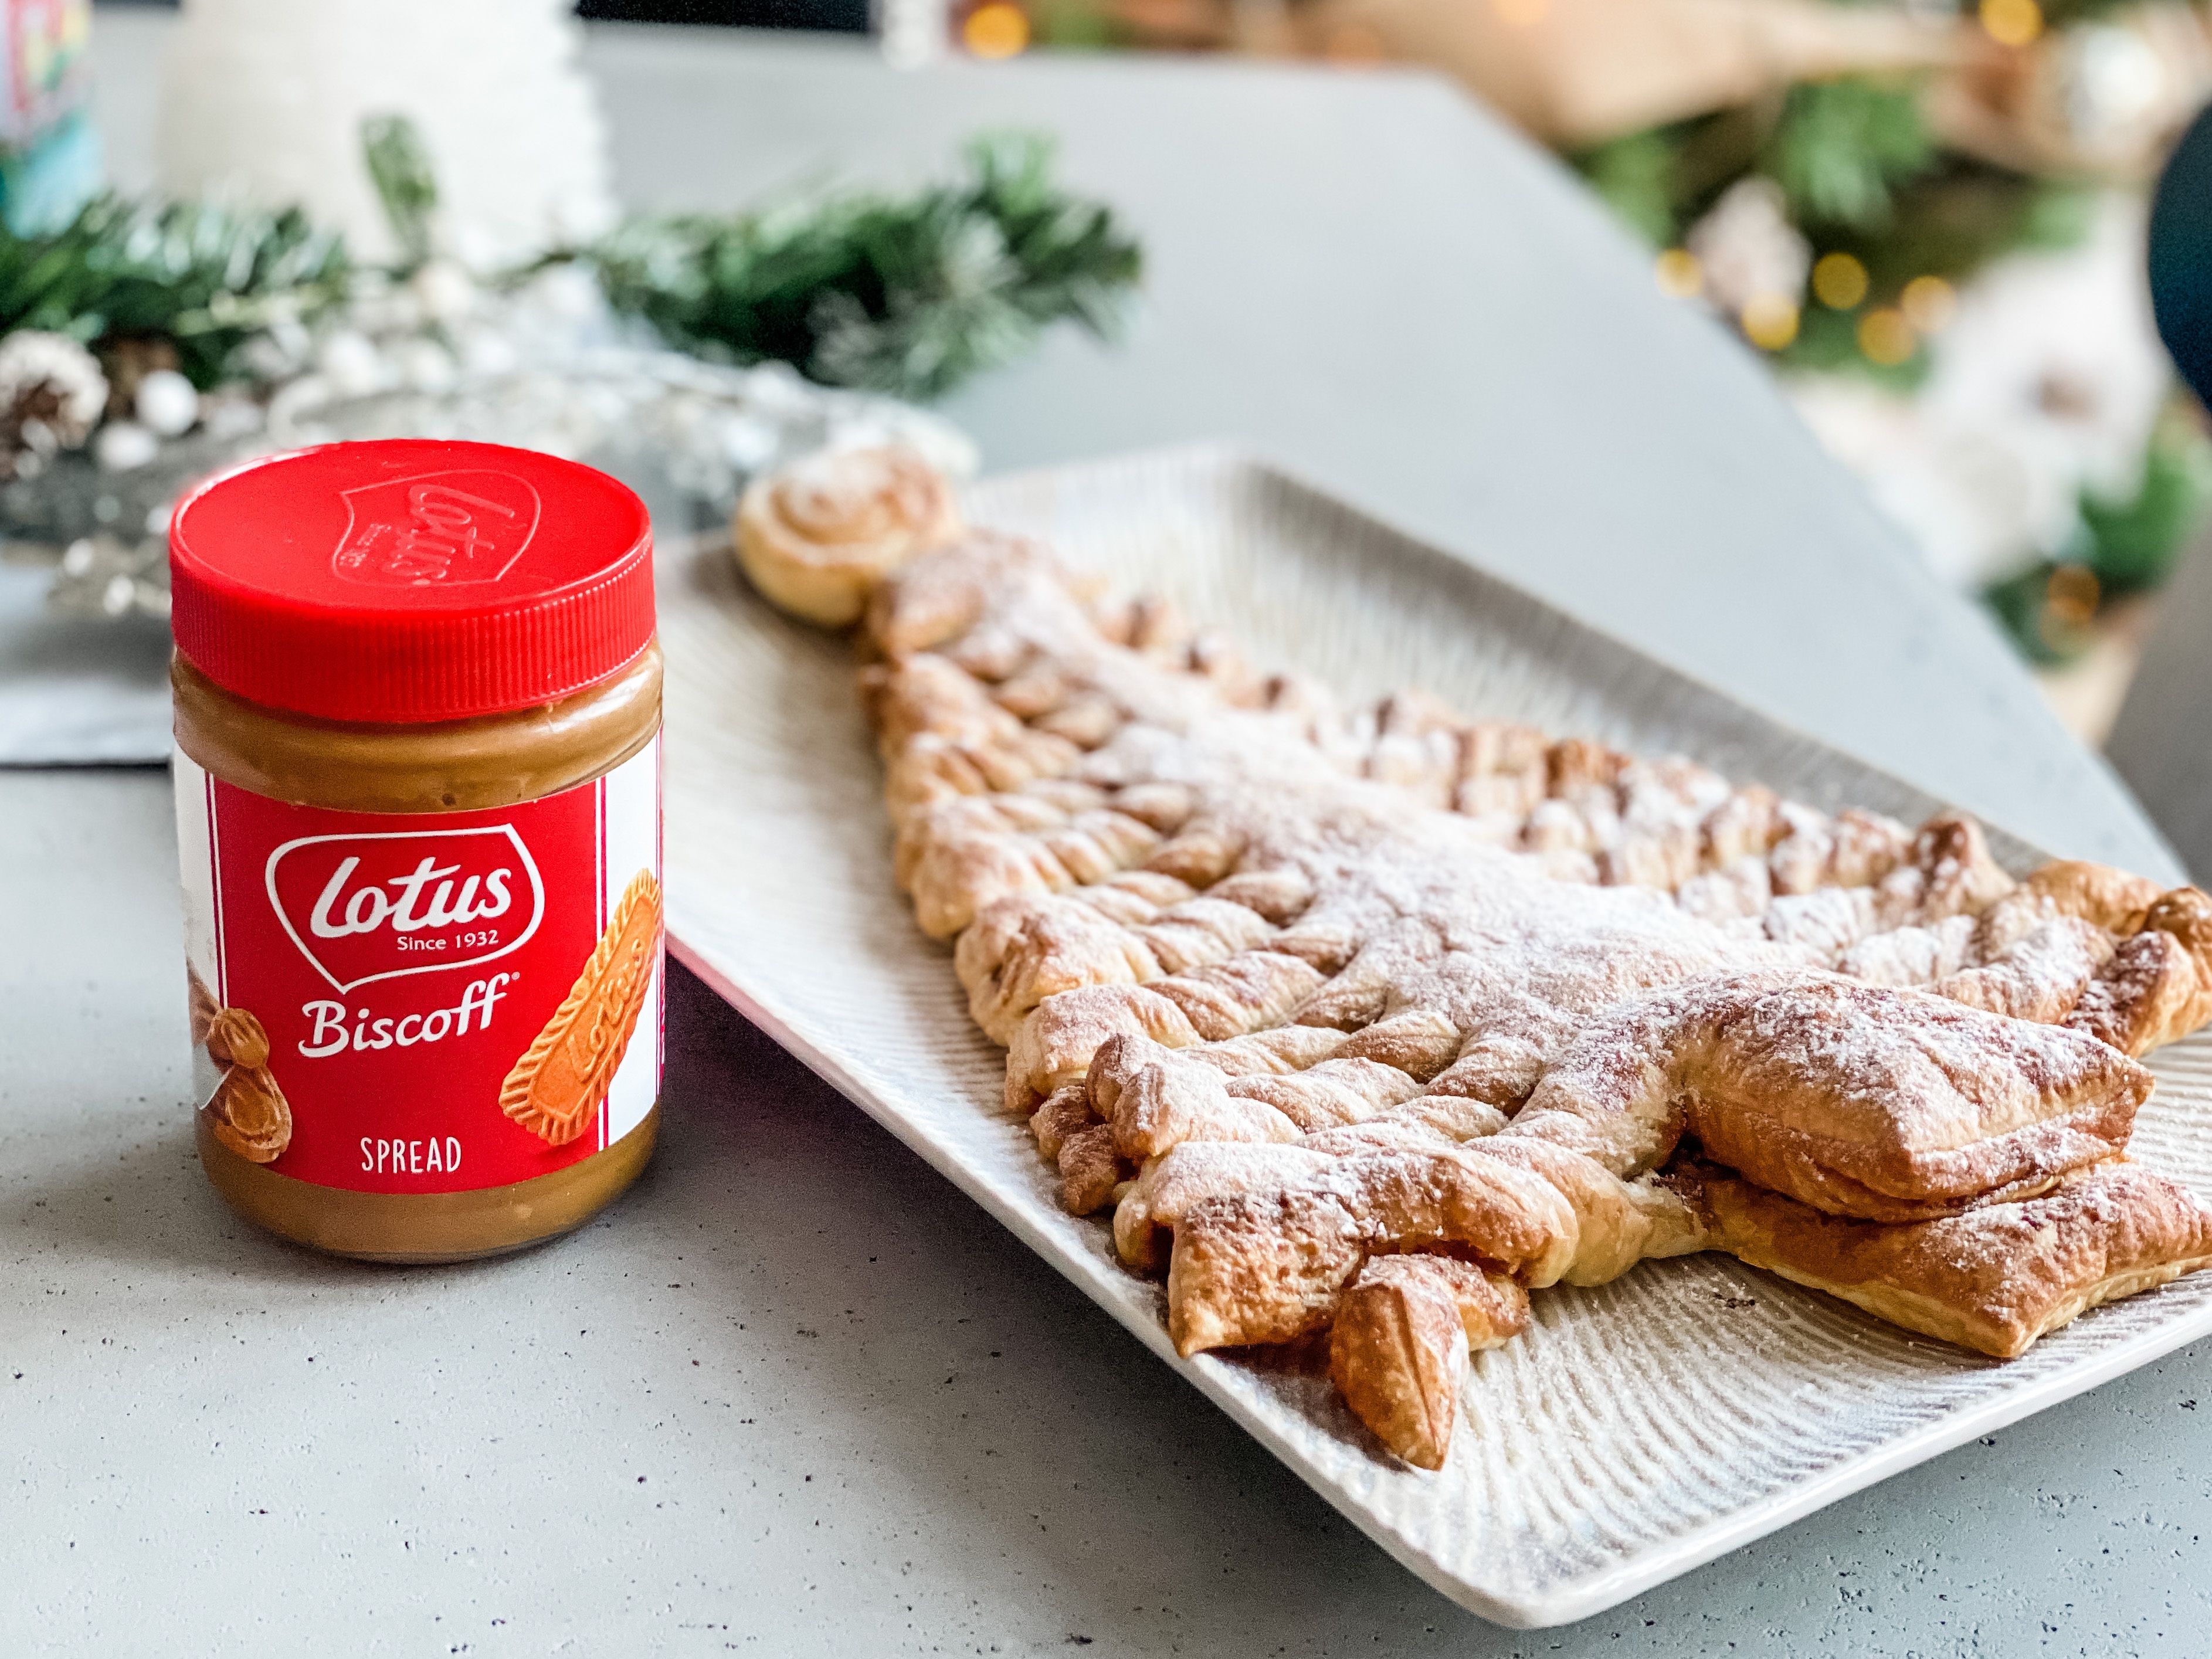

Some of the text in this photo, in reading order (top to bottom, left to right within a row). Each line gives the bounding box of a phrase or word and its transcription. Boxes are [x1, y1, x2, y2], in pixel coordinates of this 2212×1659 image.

[310, 856, 512, 939] Lotus
[396, 929, 499, 951] Since 1932
[359, 1136, 462, 1175] SPREAD
